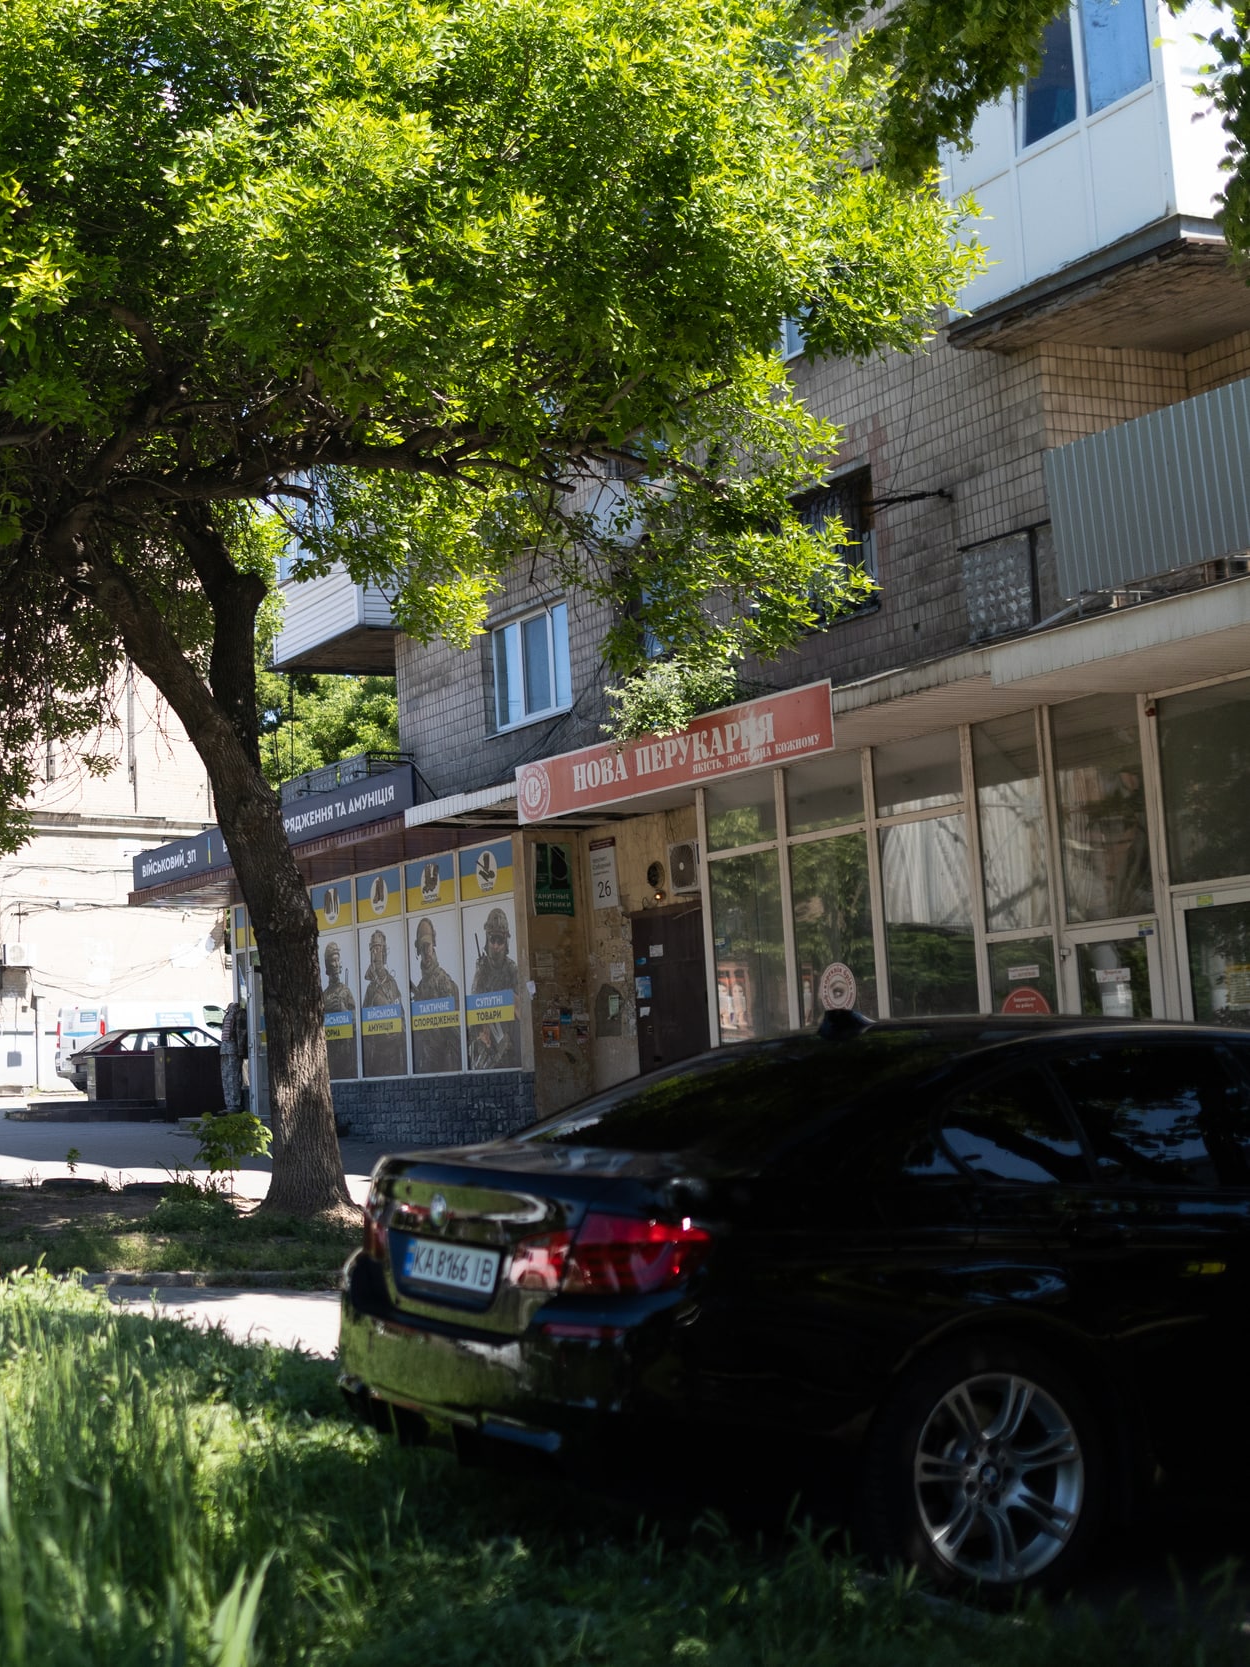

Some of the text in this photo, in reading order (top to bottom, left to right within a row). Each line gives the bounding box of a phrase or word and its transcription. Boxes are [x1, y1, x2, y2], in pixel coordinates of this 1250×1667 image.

[573, 712, 776, 793] НОВА ПЕРУКАРНЯ
[692, 758, 725, 775] ЯКІСТЬ,
[775, 733, 820, 756] КОЖНОМУ
[282, 804, 334, 834] РЯДЖЕННЯ
[335, 803, 347, 818] ТА
[348, 785, 395, 814] АМУНІЦІЯ
[597, 880, 612, 898] 26
[419, 1001, 450, 1015] ТАКТИЧНЕ
[475, 995, 503, 1008] СУПУТНІ
[325, 1014, 350, 1025] ЙСЬКОВА
[366, 1007, 398, 1020] ВІЙСЬКОВА
[476, 1010, 502, 1022] ТОВАРИ
[367, 1022, 394, 1033] АМУНІЦІЯ
[413, 1014, 459, 1028] СПОРЯДЖЕННЯ
[435, 1249, 470, 1282] 8166
